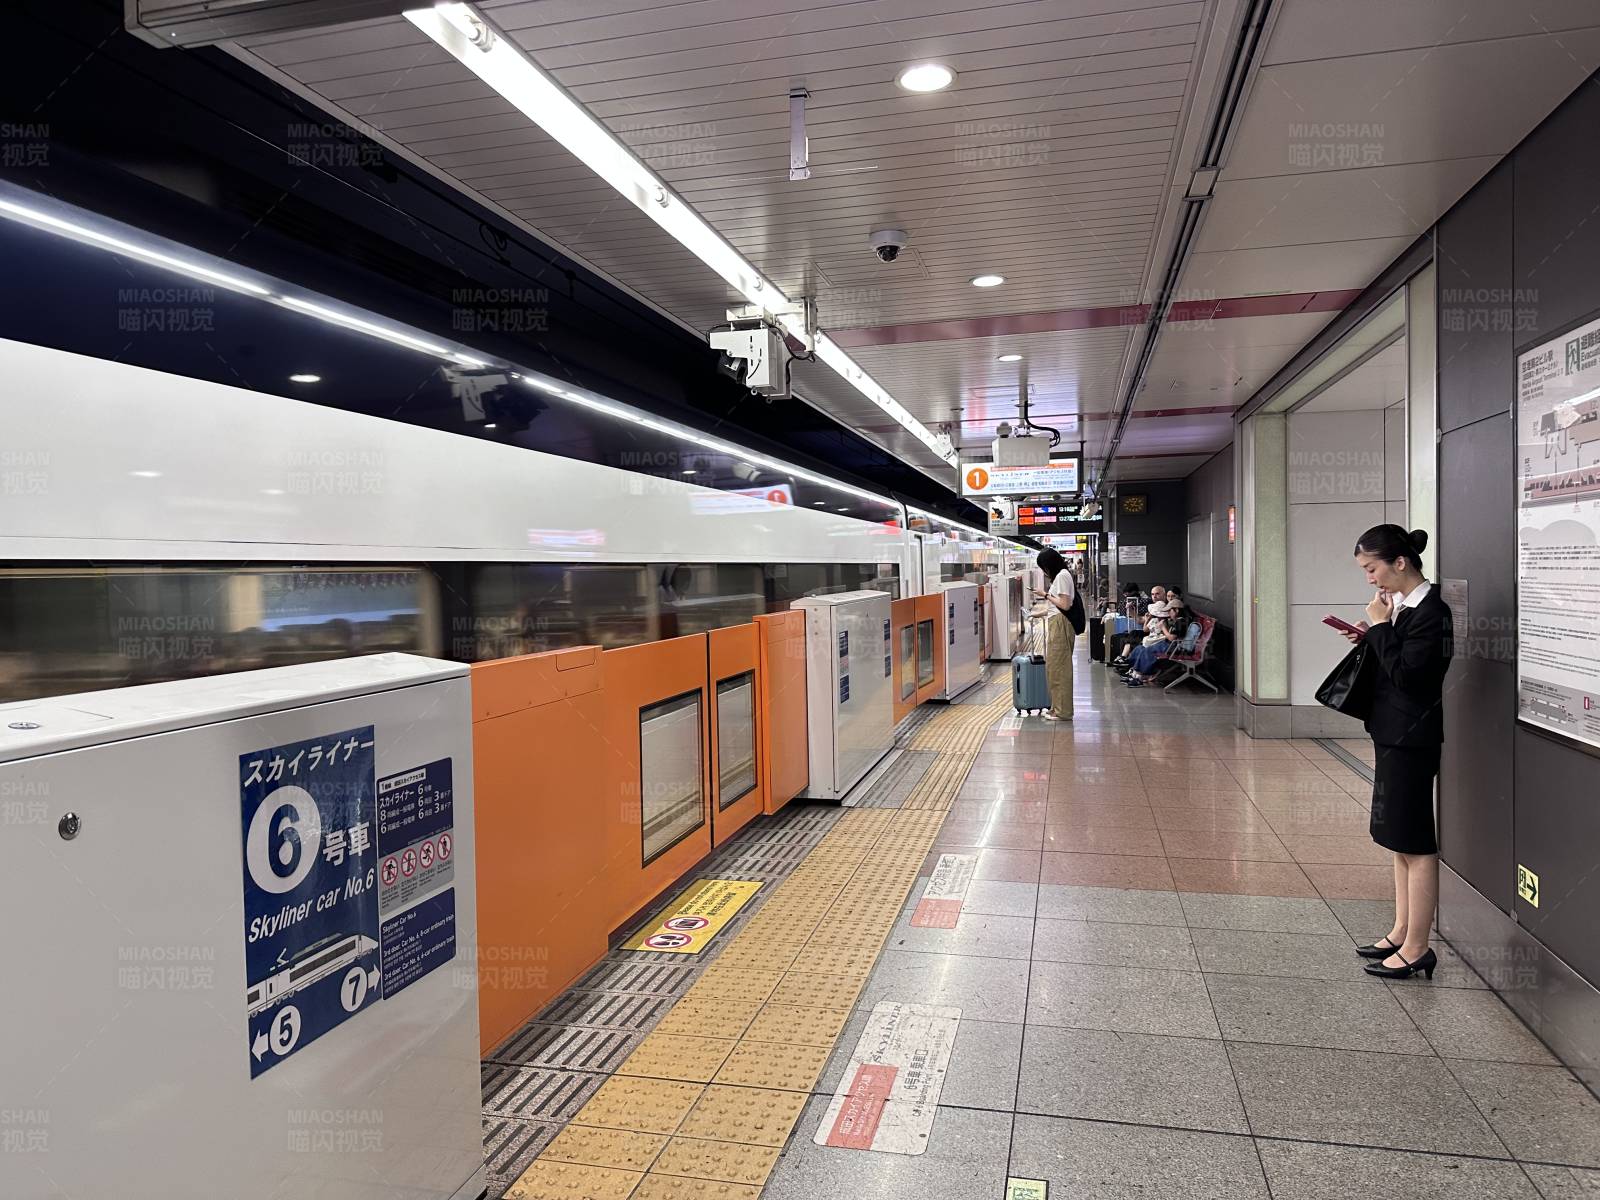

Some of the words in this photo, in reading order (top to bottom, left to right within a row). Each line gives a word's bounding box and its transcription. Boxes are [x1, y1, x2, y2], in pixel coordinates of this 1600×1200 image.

[973, 471, 980, 487] 1
[244, 736, 374, 788] スカイライナー
[380, 790, 415, 809] スカイライナー
[268, 803, 302, 878] 6
[248, 899, 313, 943] Skyliner
[316, 887, 340, 912] car
[344, 868, 375, 901] No.6
[382, 920, 400, 934] Skyliner
[349, 974, 361, 1006] 7
[279, 1012, 292, 1047] 5
